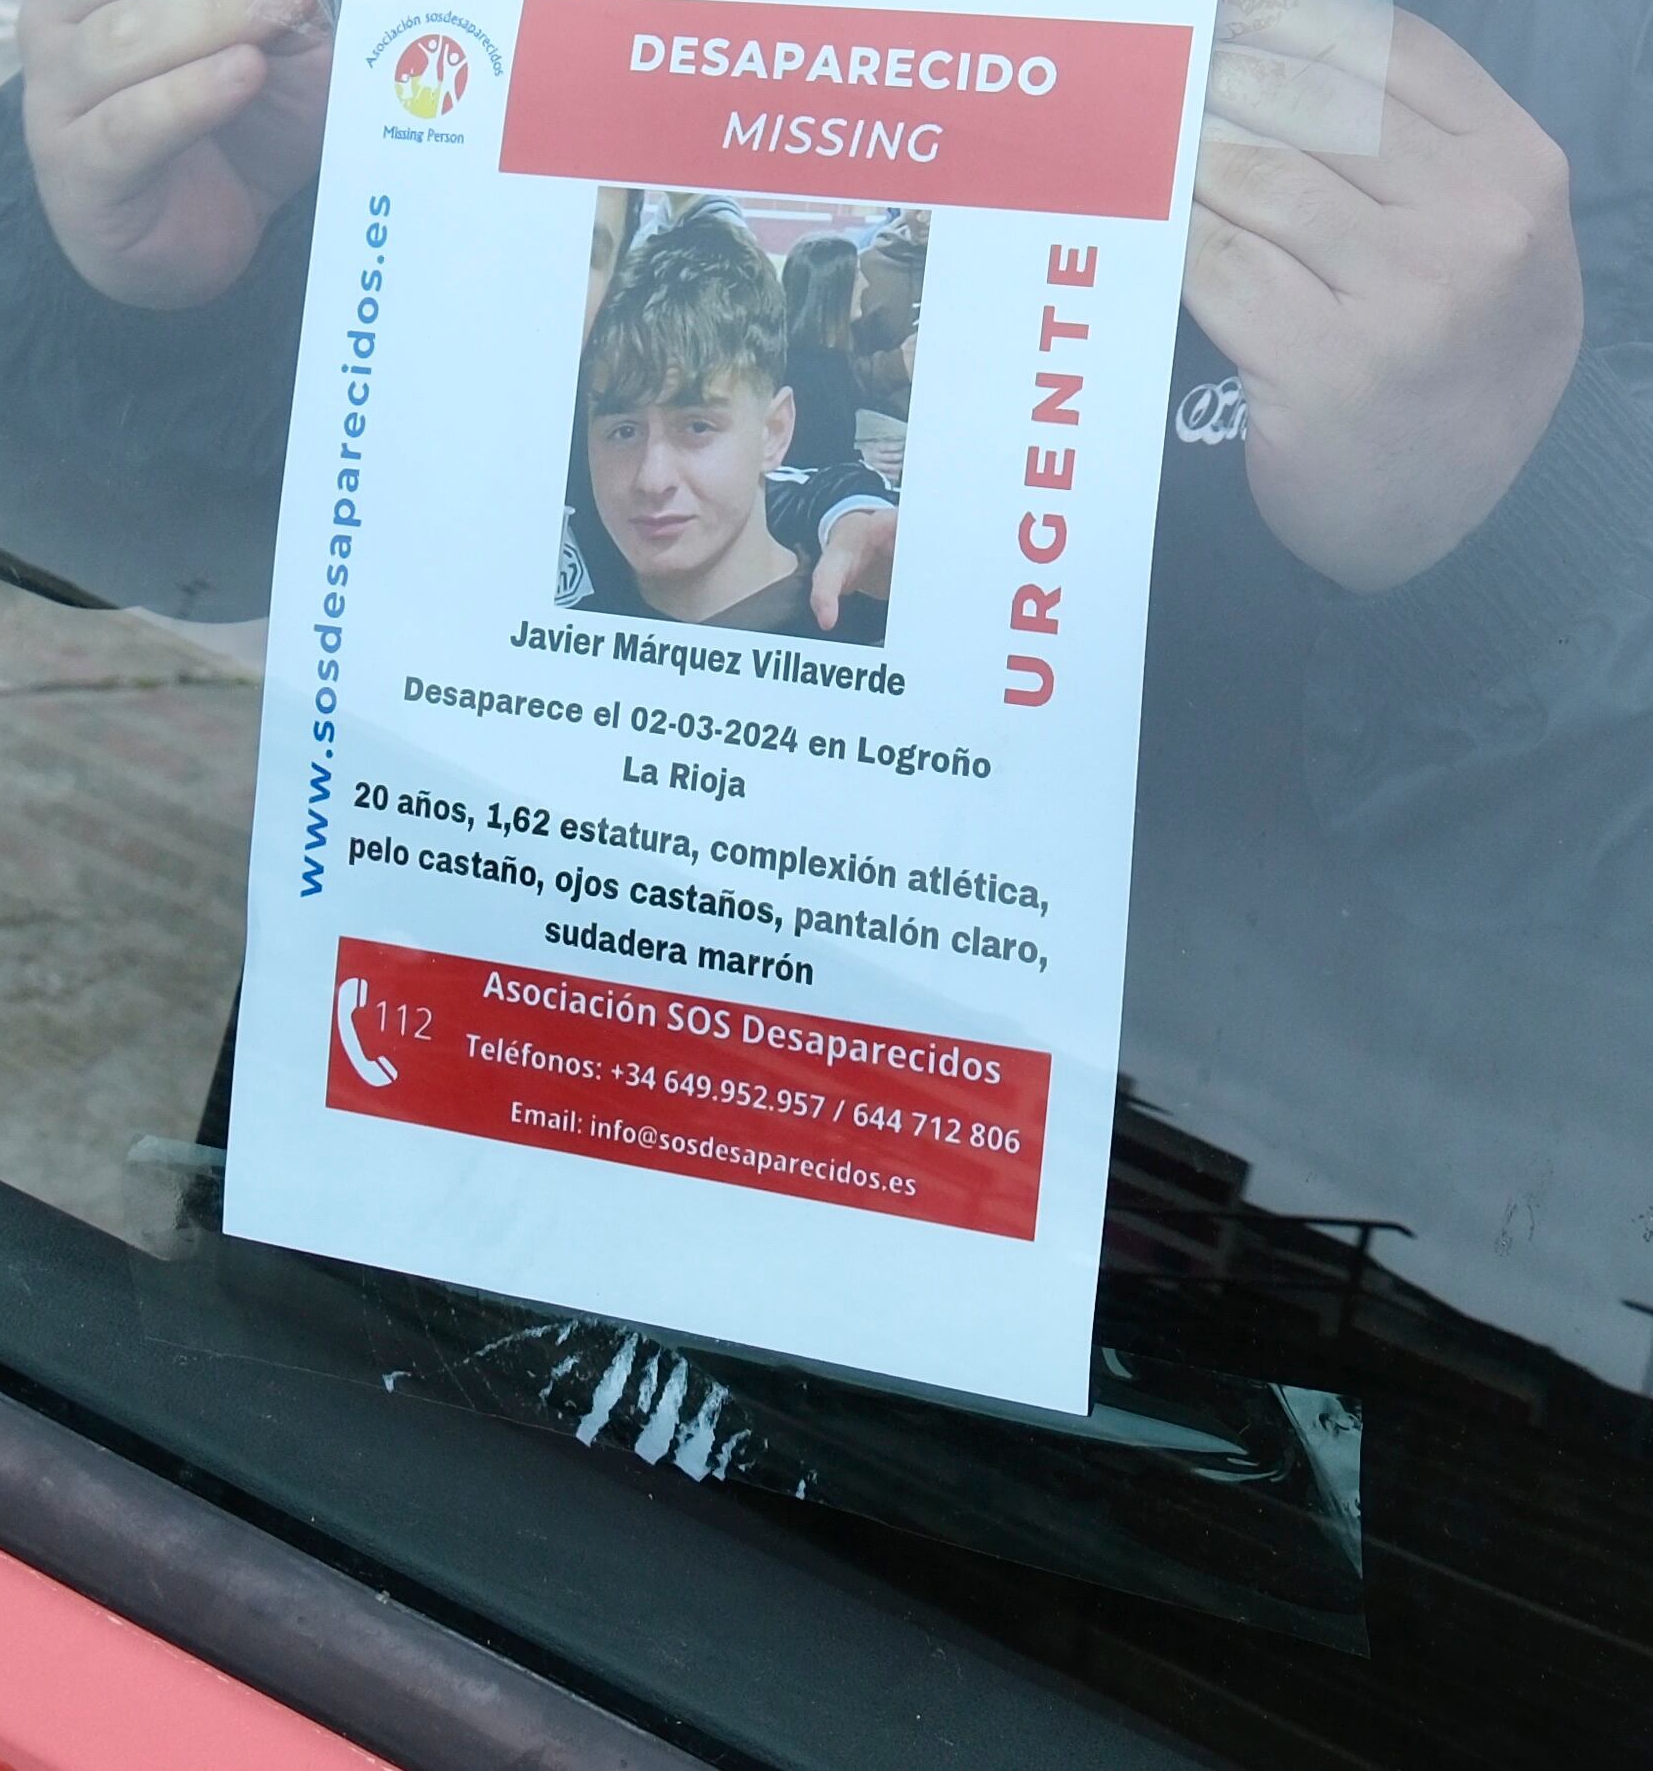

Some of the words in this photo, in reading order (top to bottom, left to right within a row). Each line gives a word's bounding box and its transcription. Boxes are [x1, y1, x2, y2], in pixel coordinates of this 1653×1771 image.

[425, 10, 504, 77] sosdesaparecidos
[629, 34, 1058, 96] DESAPARECIDO
[383, 125, 424, 143] Missing
[427, 128, 465, 144] Person
[722, 111, 944, 164] MISSING
[1004, 244, 1098, 707] URGENTE
[300, 193, 391, 898] www.sosdesaparecidos.es
[510, 620, 604, 658] Javier
[613, 631, 741, 676] Márquez
[753, 648, 906, 696] Villaverde
[404, 675, 583, 724] Desaparece
[593, 701, 621, 729] el
[631, 705, 798, 753] 02-03-2024
[809, 734, 846, 760] en
[857, 736, 992, 779] Logroño
[623, 756, 658, 785] La
[669, 761, 746, 801] Rioja
[354, 781, 389, 811] 20
[397, 790, 475, 831] años,
[487, 802, 550, 838] 1,62
[560, 817, 699, 865] estatura,
[710, 840, 896, 888] complexión
[908, 866, 1049, 917] atlética,
[348, 836, 409, 866] pelo
[418, 849, 544, 896] castaño,
[555, 866, 619, 903] ojos
[630, 882, 783, 933] castaños,
[794, 906, 940, 950] pantalón
[951, 926, 1048, 973] claro,
[544, 920, 687, 965] sudadera
[698, 945, 814, 986] marrón
[376, 999, 433, 1041] 112
[483, 971, 657, 1027] Asociación
[667, 1001, 731, 1039] SOS
[742, 1013, 1001, 1085] Desaparecidos
[466, 1034, 602, 1081] Teléfonos:
[611, 1062, 657, 1090] +34
[664, 1069, 825, 1119] 649.952.957
[833, 1100, 845, 1122] /
[853, 1102, 902, 1134] 644
[911, 1112, 961, 1144] 712
[970, 1123, 1021, 1155] 806
[511, 1101, 583, 1135] Email:
[589, 1114, 917, 1197] info@sosdesaparecidos.es
